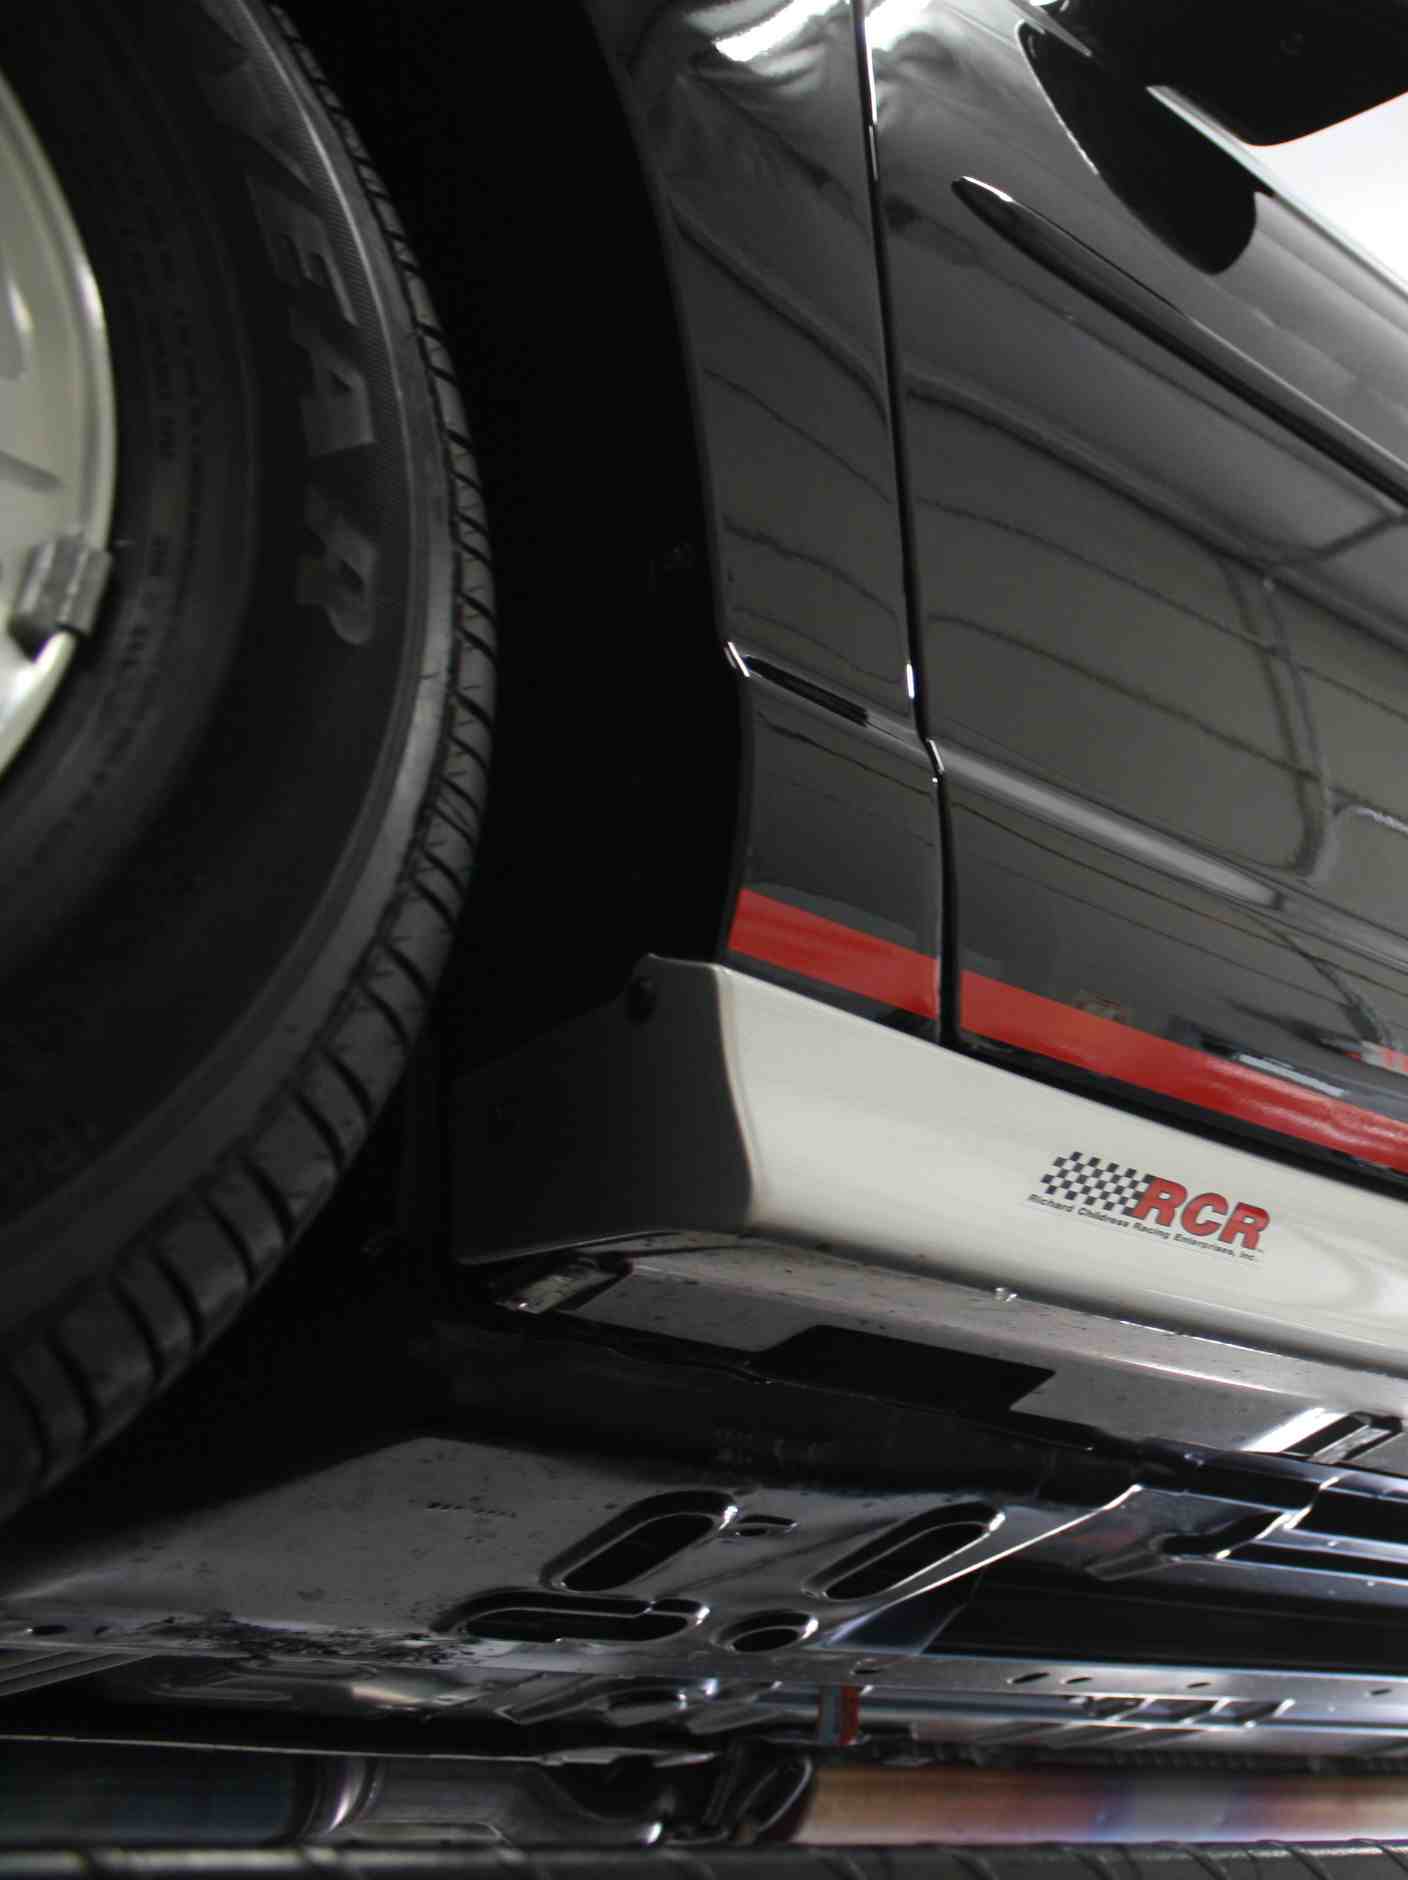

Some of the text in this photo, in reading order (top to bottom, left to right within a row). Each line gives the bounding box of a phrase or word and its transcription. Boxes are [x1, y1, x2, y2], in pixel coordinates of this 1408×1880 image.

[1027, 1194, 1074, 1213] Richard
[1132, 1222, 1171, 1241] Racing
[1131, 1176, 1271, 1251] RCR
